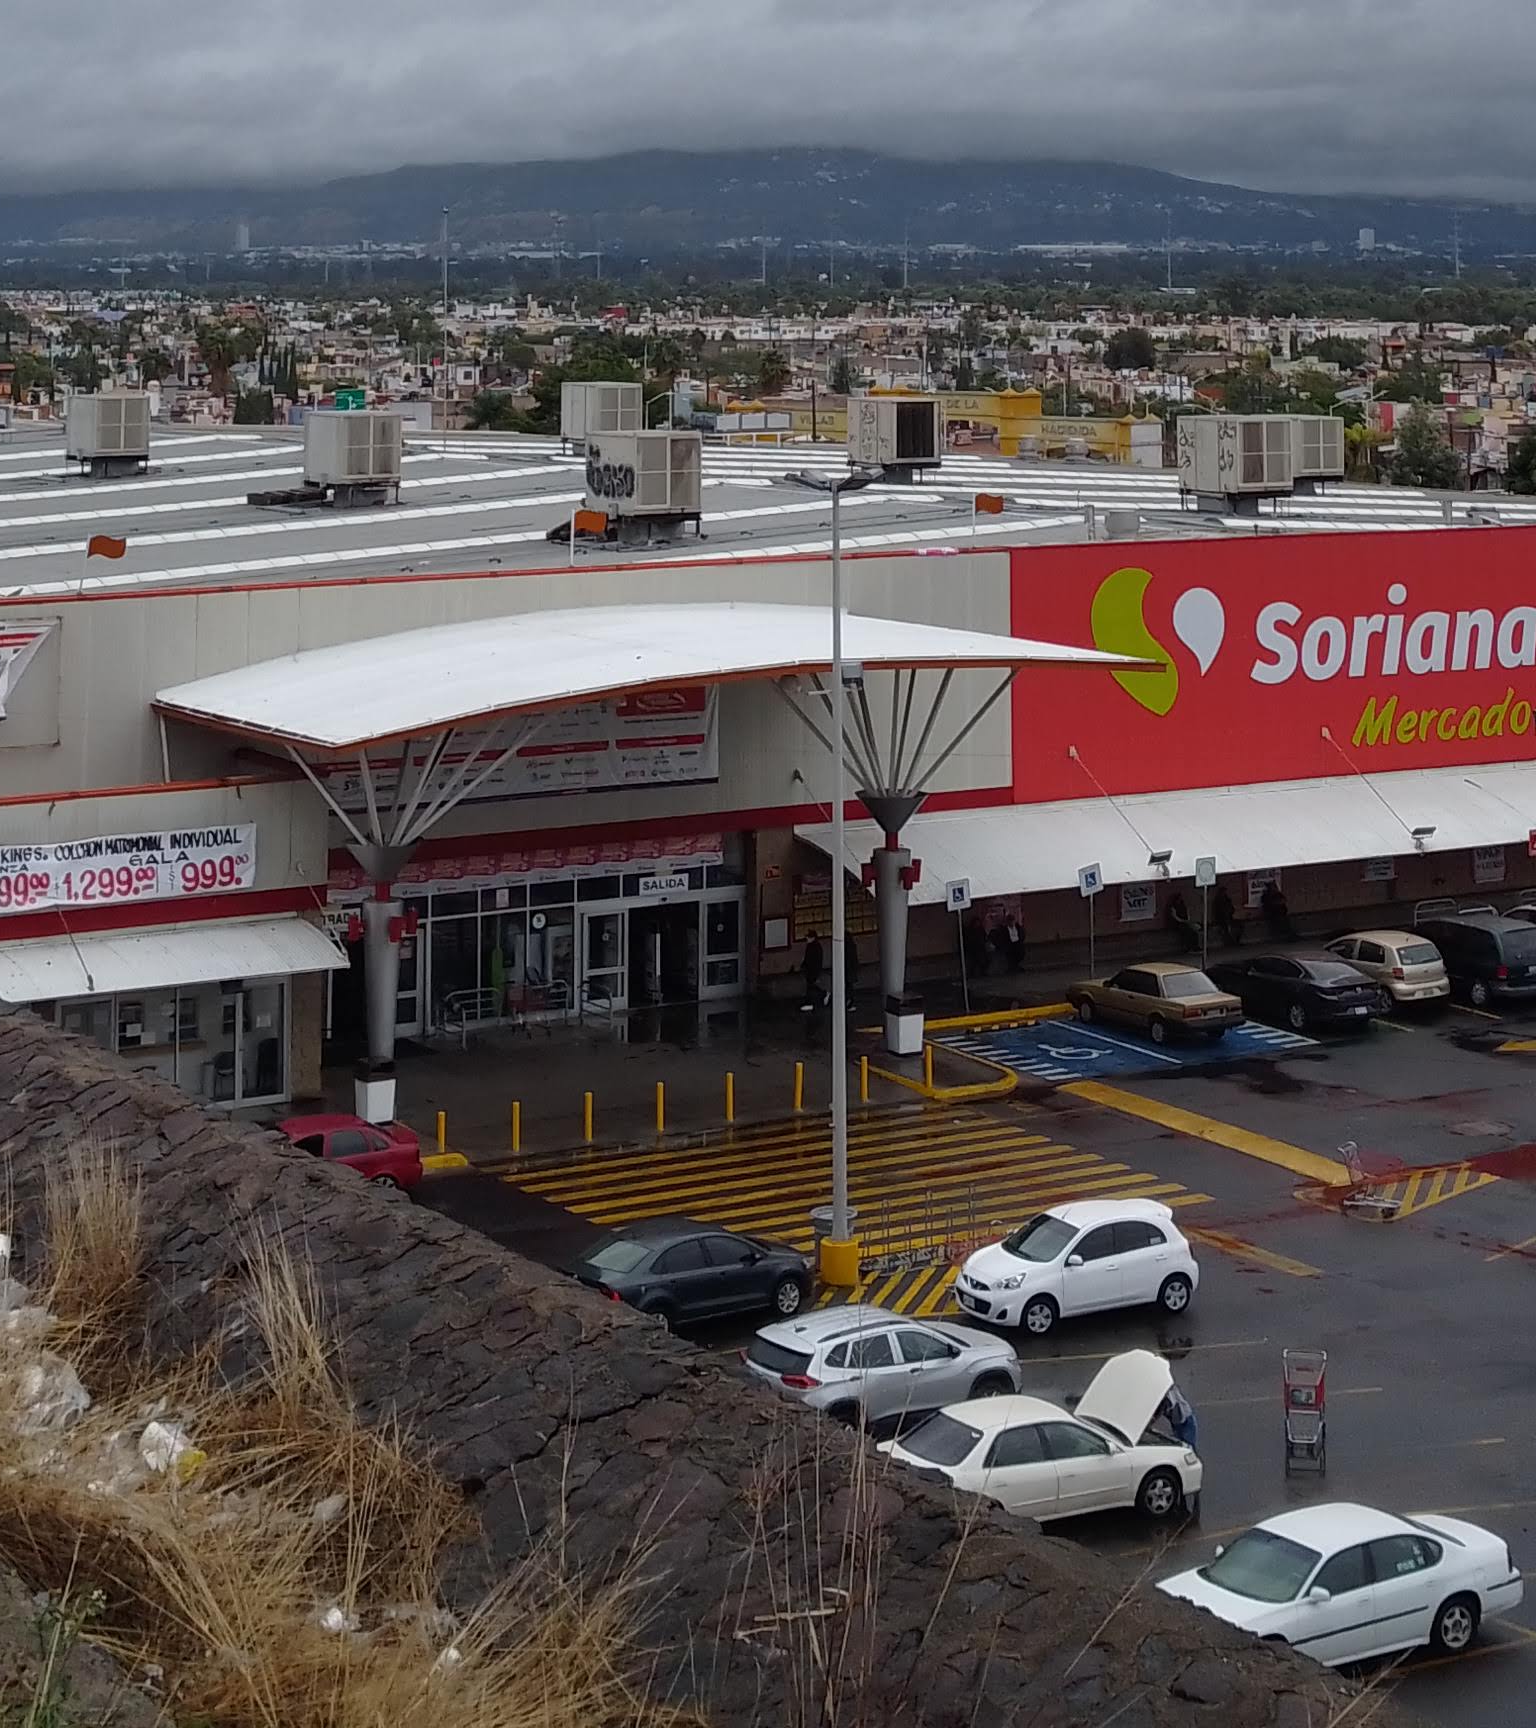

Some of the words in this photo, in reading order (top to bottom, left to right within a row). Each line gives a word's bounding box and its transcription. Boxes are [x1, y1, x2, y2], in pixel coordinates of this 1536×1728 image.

[964, 399, 979, 410] LA
[1040, 423, 1097, 436] HACIENDA
[1352, 686, 1532, 747] Mercado
[0, 846, 49, 864] KINGS.
[54, 838, 104, 861] COLCHON
[104, 834, 165, 855] MATRIMONIAL
[169, 828, 243, 850] INDIVIDUAL
[129, 851, 190, 866] GALA
[642, 876, 686, 892] SALIDA
